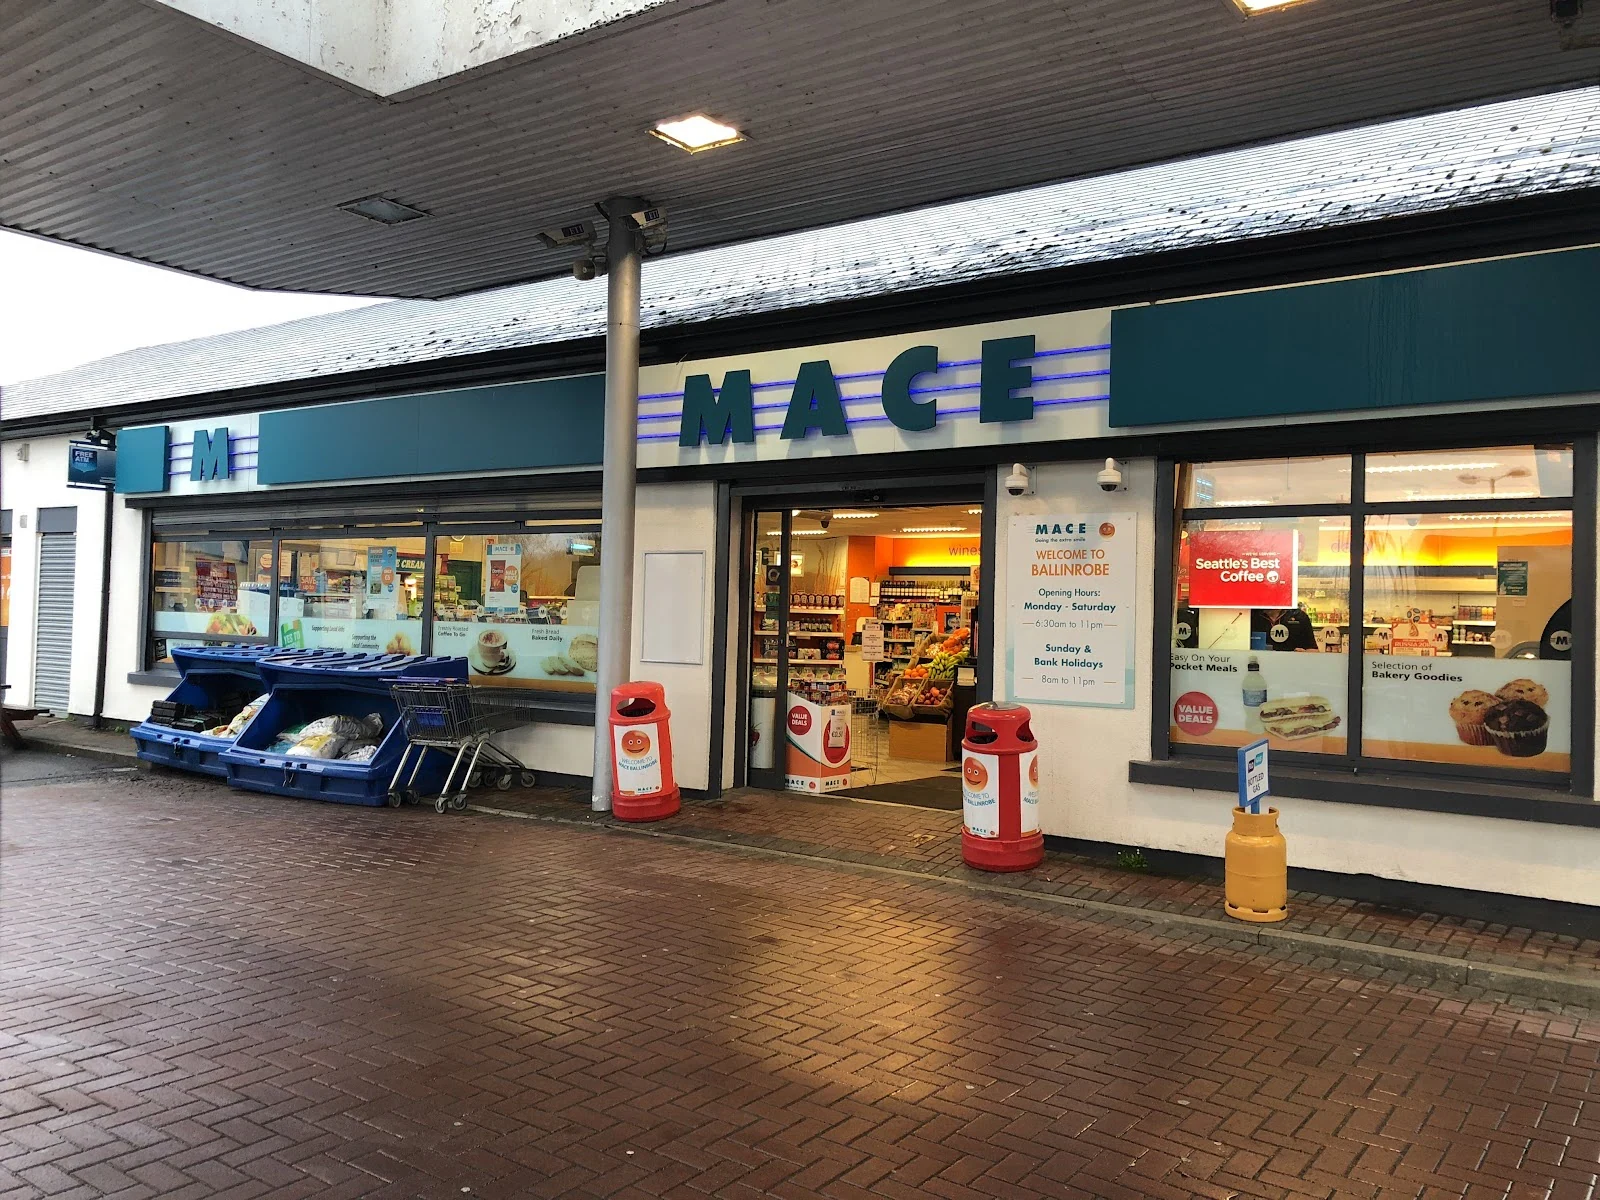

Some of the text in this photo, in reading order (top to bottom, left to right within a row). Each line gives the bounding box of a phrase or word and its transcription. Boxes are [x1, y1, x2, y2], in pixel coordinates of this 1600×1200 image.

[678, 334, 1036, 447] MACE
[75, 450, 93, 459] FREE
[190, 427, 230, 481] M
[1035, 523, 1086, 535] MACE
[1036, 549, 1105, 560] WELCOME TO
[1195, 557, 1280, 570] Seattle's Best
[1031, 563, 1110, 577] BALLINROBE
[301, 576, 317, 585] SAVE
[1220, 570, 1265, 582] Coffee
[1038, 587, 1101, 599] Opening Hours:
[1023, 601, 1062, 613] Monday
[1071, 602, 1116, 614] Saturday
[1035, 619, 1103, 631] 6:30am to 11pm
[352, 633, 370, 642] Supporting
[549, 635, 563, 643] Daily
[1275, 629, 1285, 638] M
[1555, 636, 1568, 645] M
[361, 642, 380, 651] Community
[1045, 643, 1092, 655] Sunday &
[1191, 653, 1205, 662] On
[1208, 655, 1231, 663] Your
[1034, 657, 1104, 671] Bank Holidays
[1170, 662, 1238, 673] Pocket Meals
[1371, 661, 1433, 671] Selection of
[1041, 674, 1096, 688] 8am to 11pm
[1372, 671, 1463, 682] Bakery Goodies
[1178, 704, 1214, 715] VALUE
[791, 712, 808, 720] VALUE
[1178, 714, 1213, 724] DEALS
[791, 719, 808, 727] DEALS
[618, 759, 658, 771] MACE BALLINROBE
[621, 757, 646, 765] WELCOME
[1247, 772, 1265, 787] BOTTLED
[1252, 783, 1261, 793] GAS
[967, 798, 996, 807] BALLINROBE
